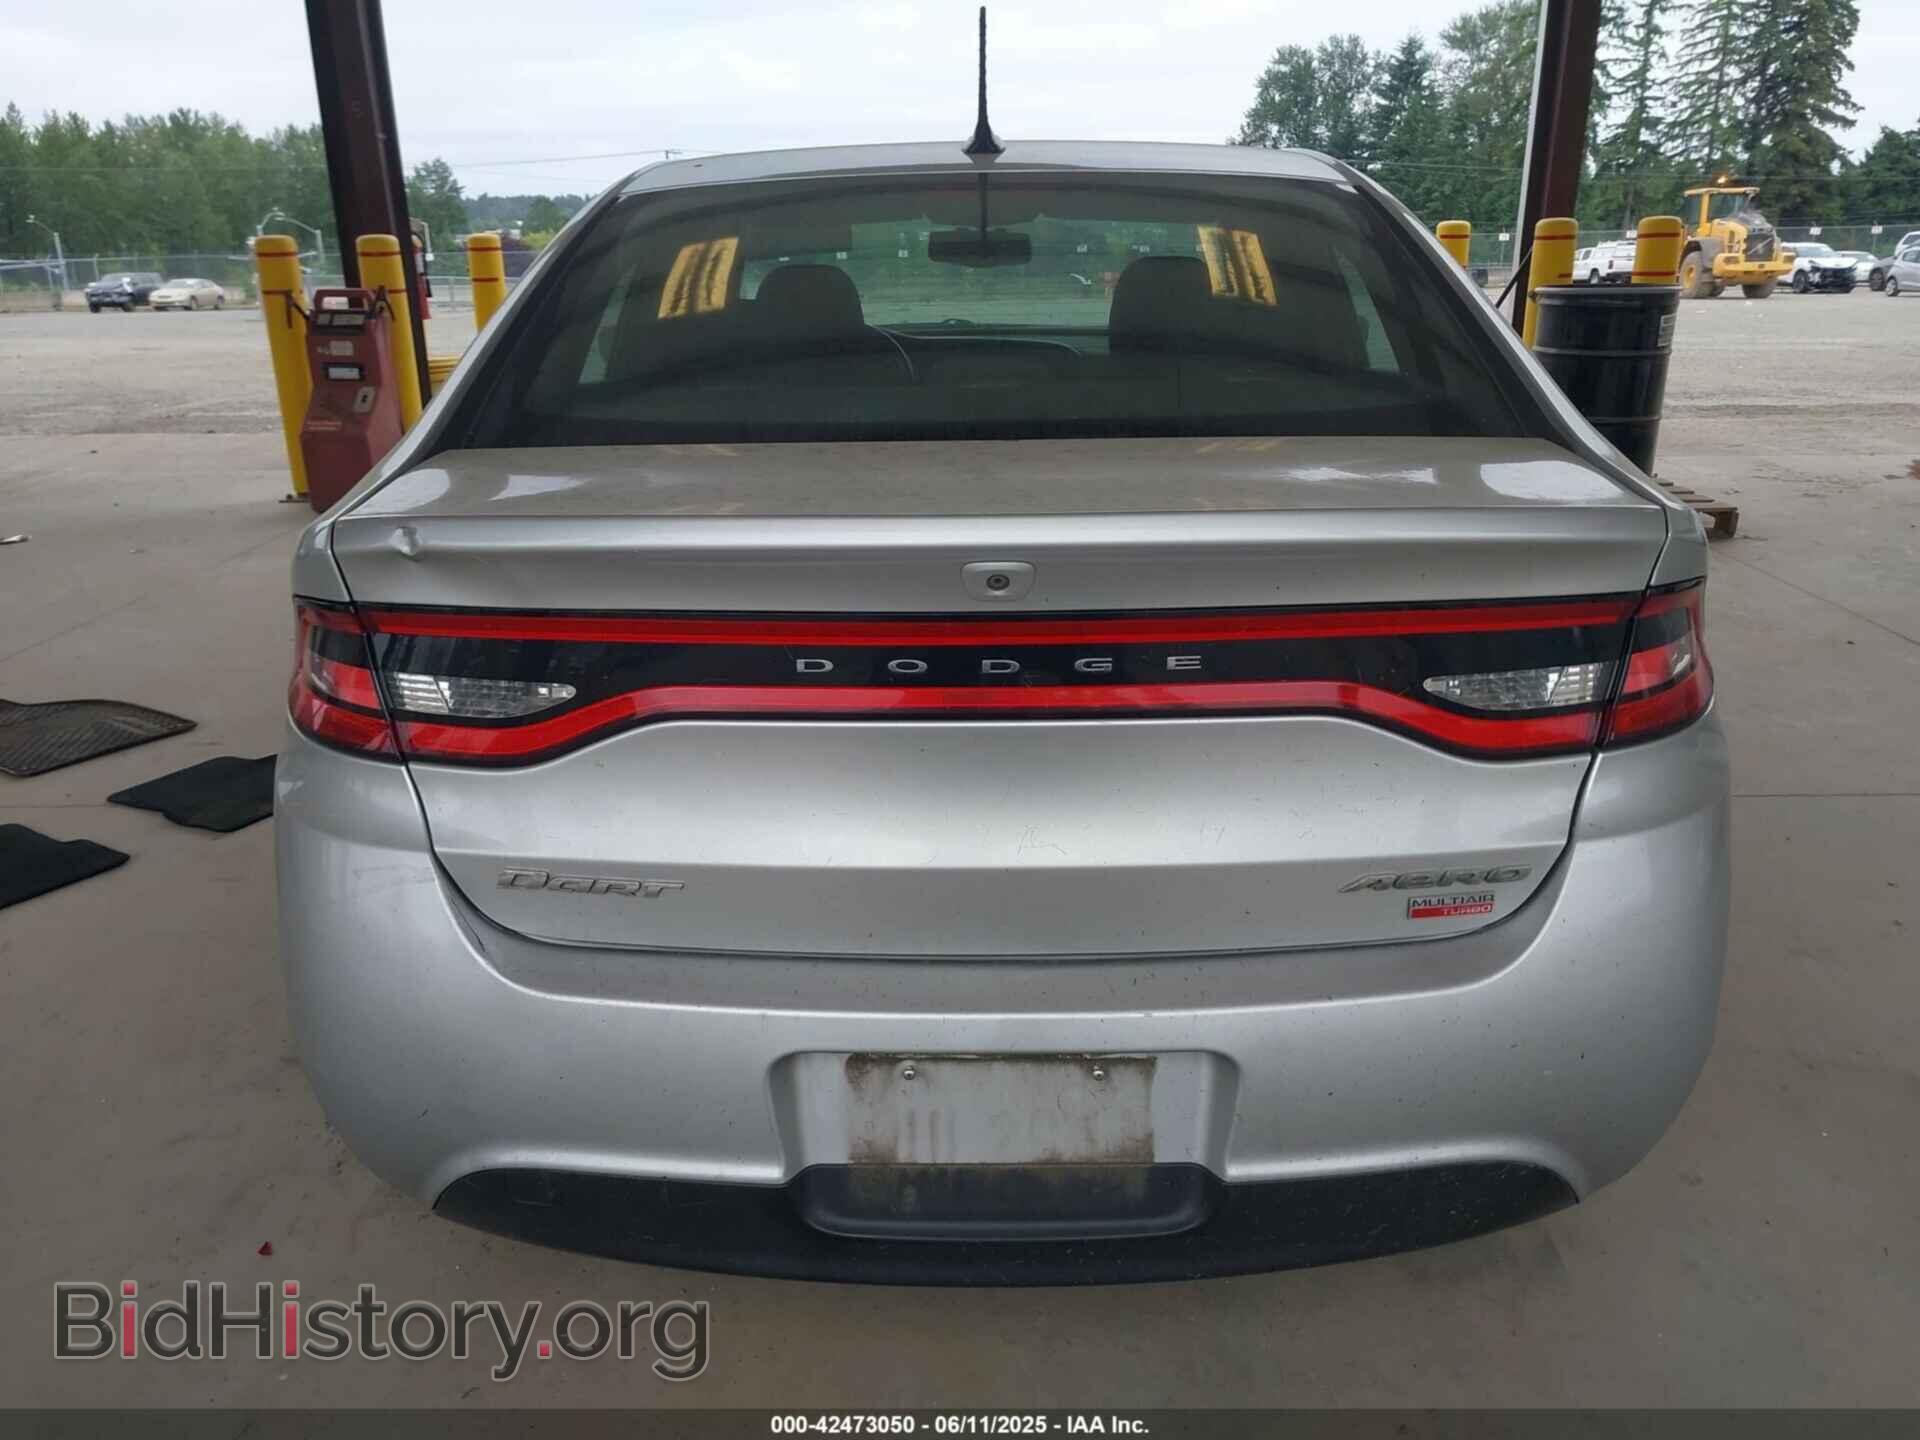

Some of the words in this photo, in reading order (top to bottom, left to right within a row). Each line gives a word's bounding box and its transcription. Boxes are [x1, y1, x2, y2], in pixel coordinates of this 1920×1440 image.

[796, 655, 1202, 673] DODGE
[1338, 865, 1533, 893] AERO
[1411, 894, 1496, 908] MULTIAIR
[1442, 904, 1493, 917] TURBO
